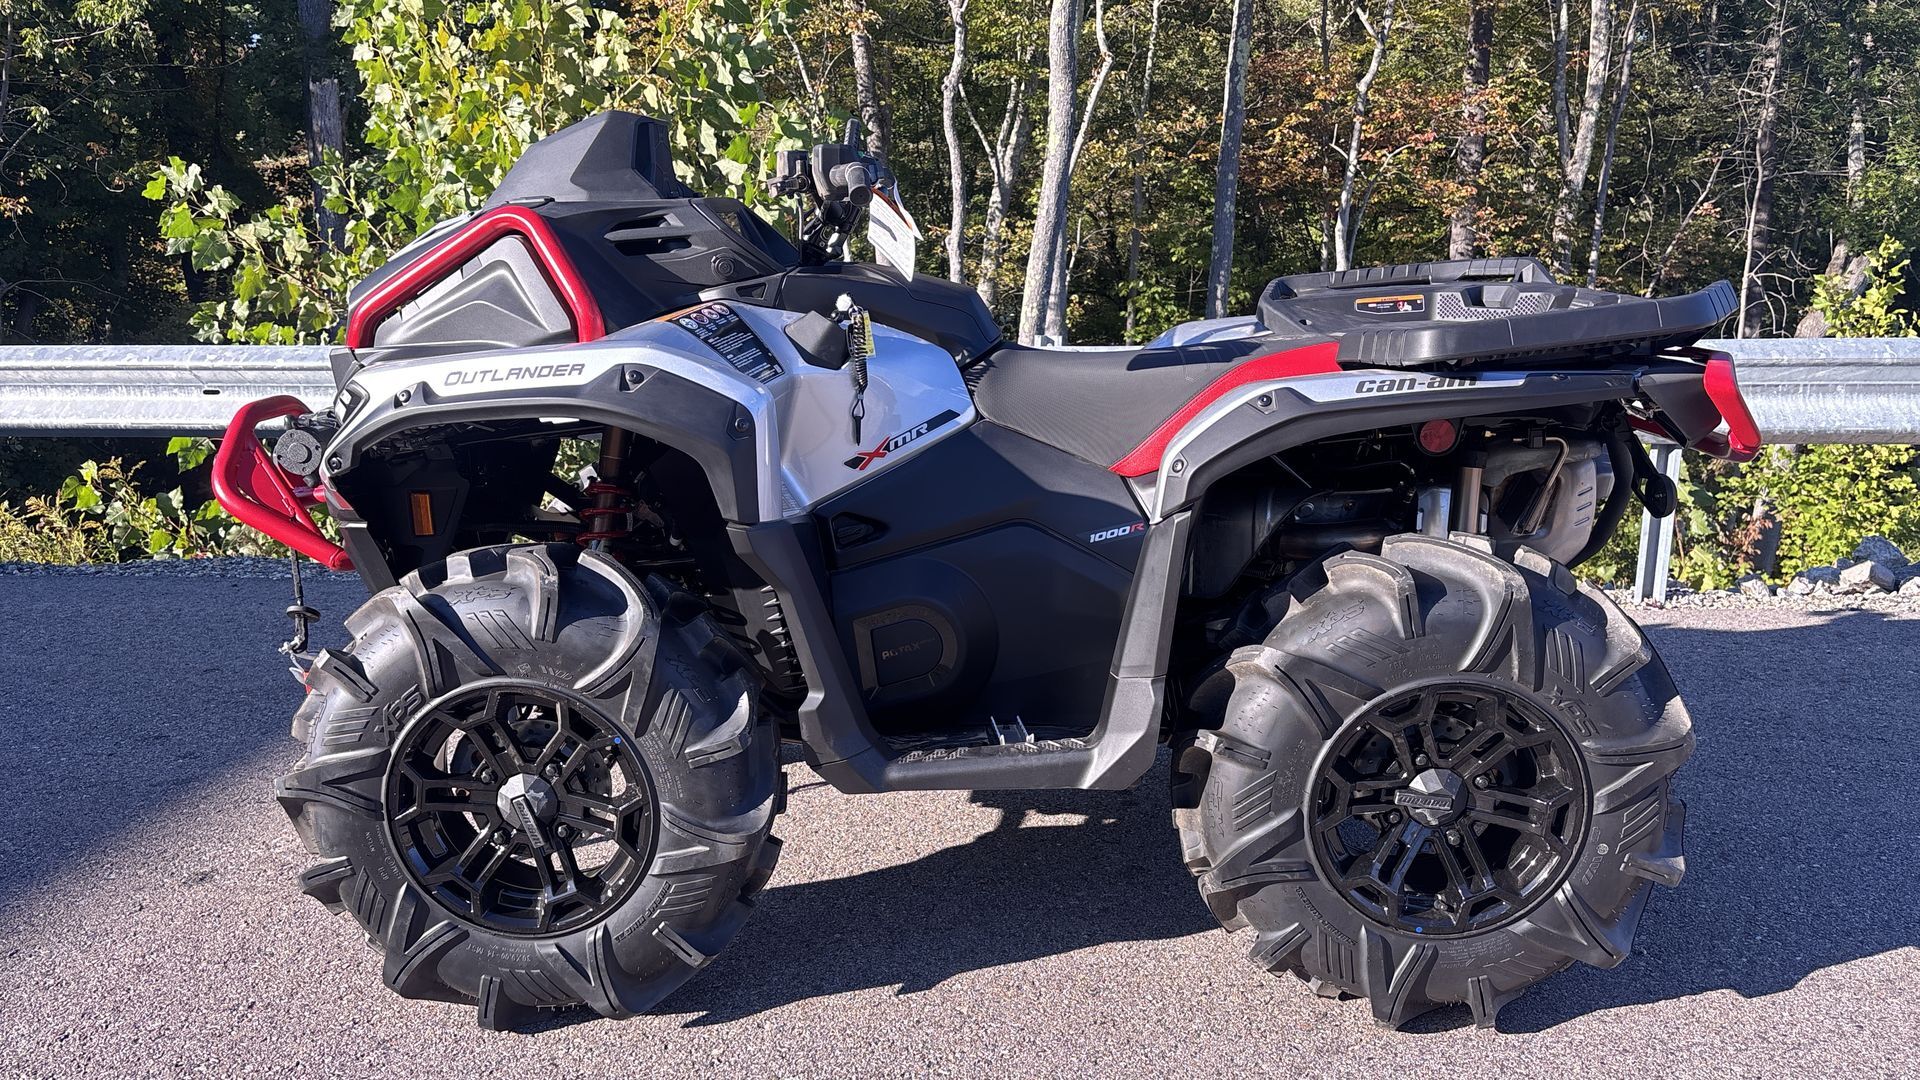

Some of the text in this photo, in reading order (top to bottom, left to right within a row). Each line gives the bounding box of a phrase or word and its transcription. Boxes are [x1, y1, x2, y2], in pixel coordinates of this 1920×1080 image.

[444, 363, 585, 387] OUTLANDER
[1355, 376, 1477, 394] can-am
[1089, 521, 1145, 543] 1000R
[374, 683, 423, 747] XPS
